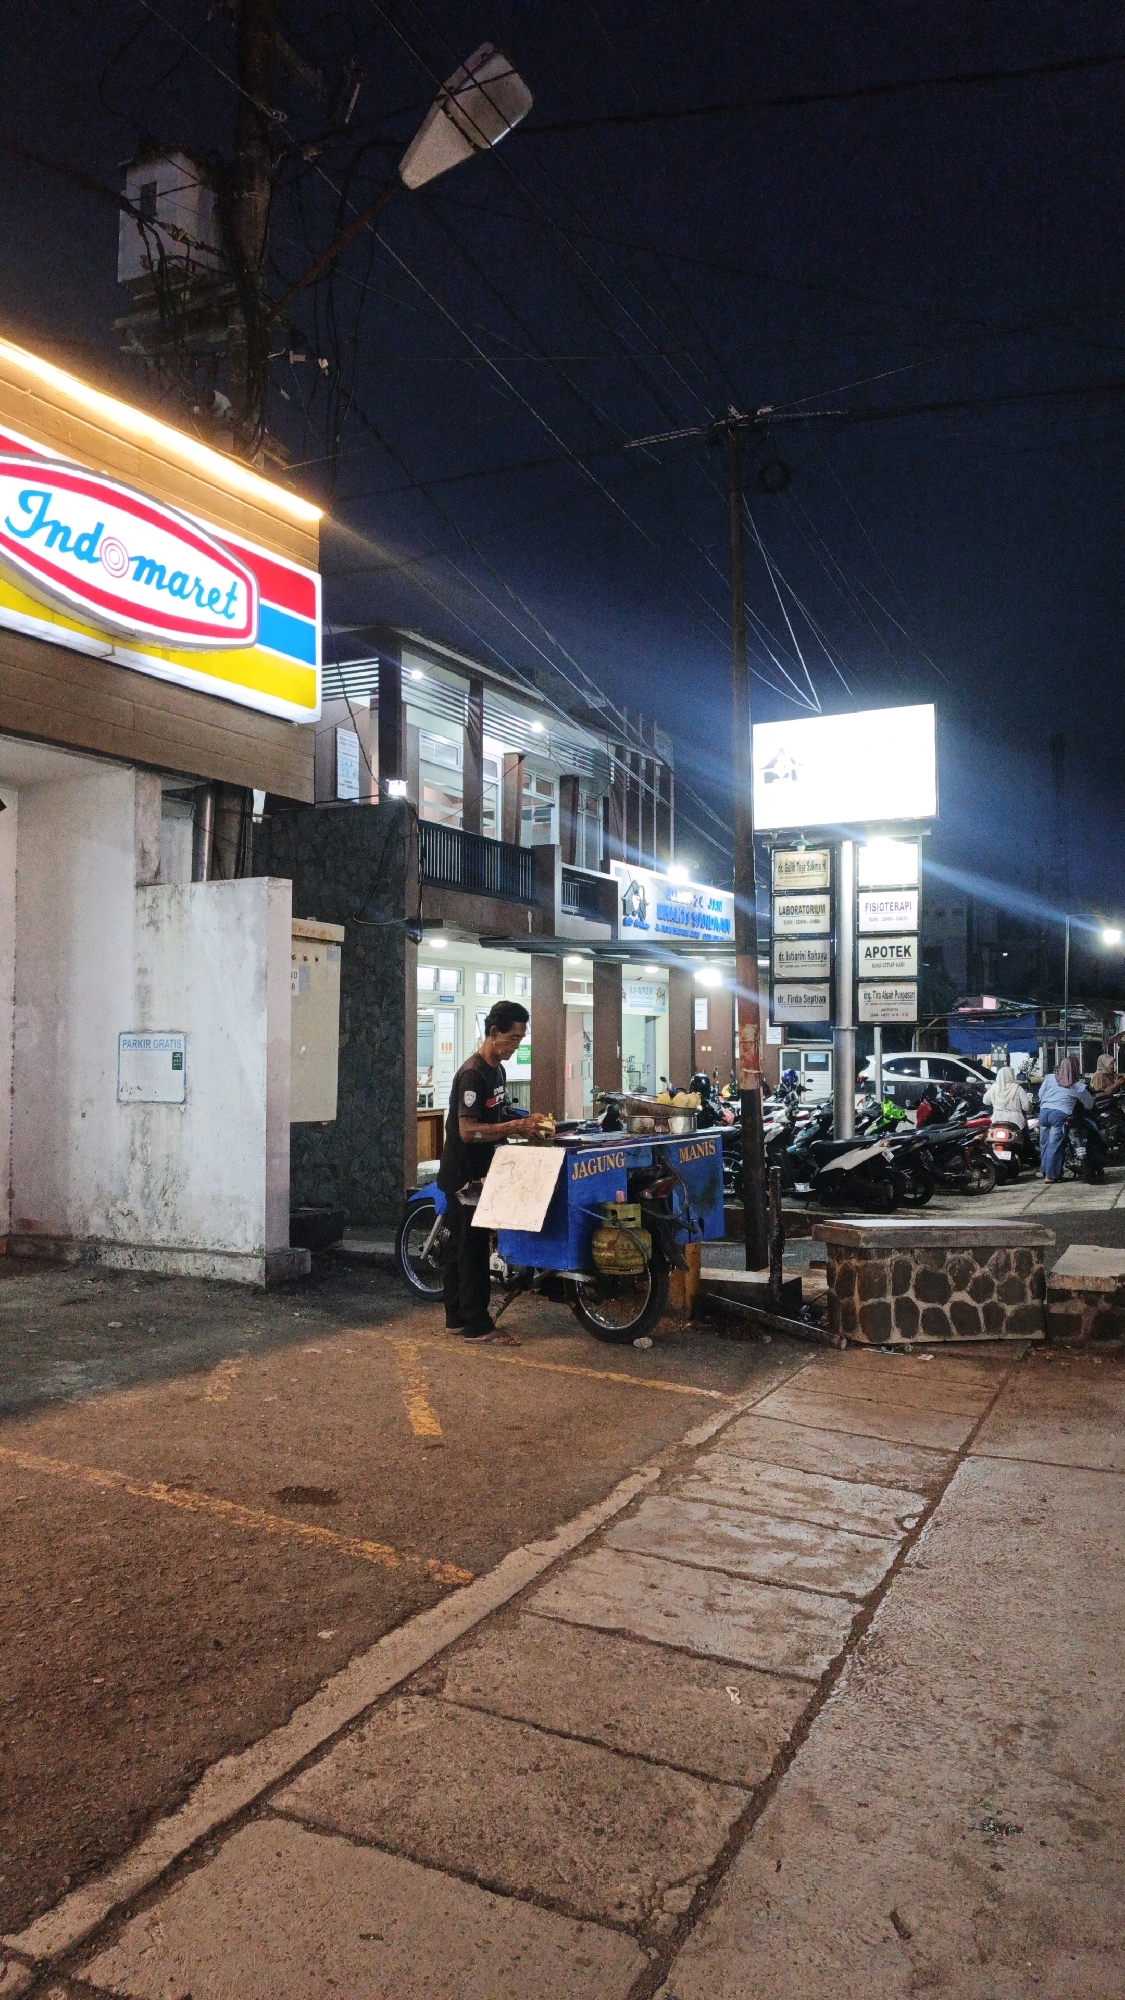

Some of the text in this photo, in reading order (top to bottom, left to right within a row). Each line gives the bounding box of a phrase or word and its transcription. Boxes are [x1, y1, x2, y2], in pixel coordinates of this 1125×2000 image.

[4, 489, 238, 620] Indomaret
[778, 904, 826, 915] LABORATORIUM
[865, 901, 912, 912] FISIOTERAPI
[865, 945, 912, 958] APOTEK
[788, 995, 802, 1003] Firda
[804, 995, 826, 1005] Septian
[122, 1039, 182, 1049] PARKIR GRATIS
[572, 1140, 716, 1180] JAGUNG MANIS
